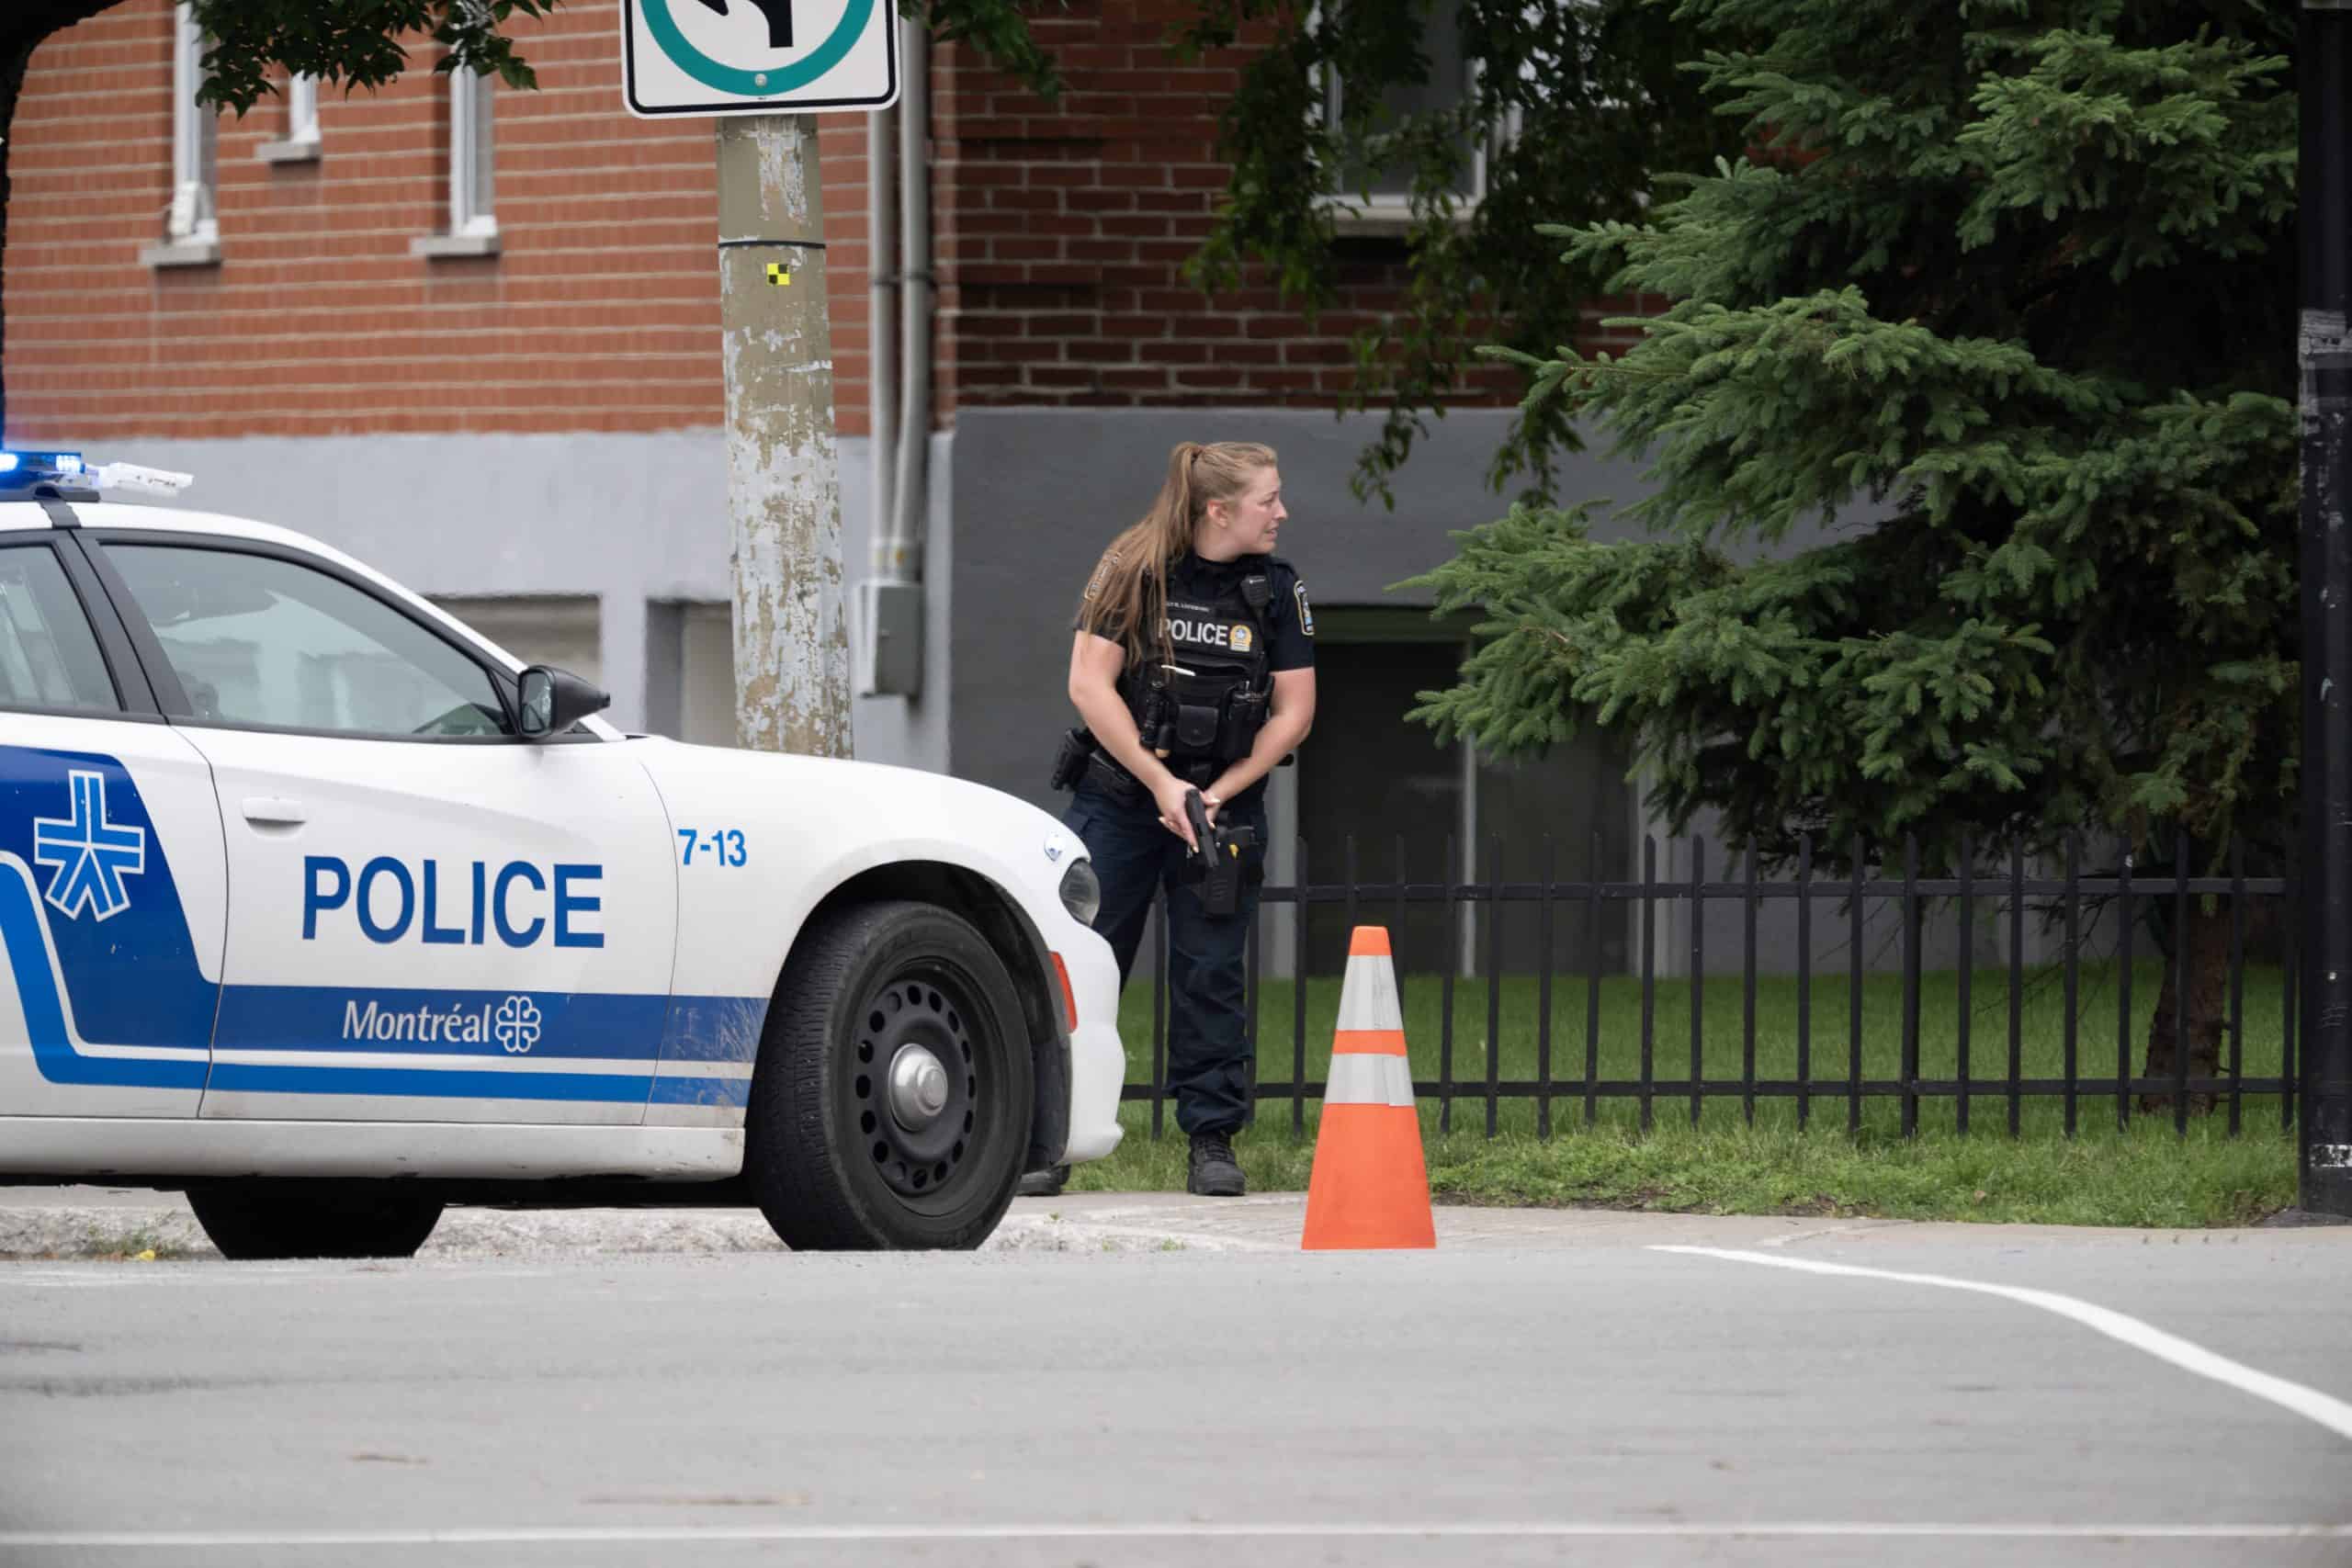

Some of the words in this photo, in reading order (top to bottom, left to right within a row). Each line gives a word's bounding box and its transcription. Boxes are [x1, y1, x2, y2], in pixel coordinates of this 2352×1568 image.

[1158, 617, 1228, 646] POLICE
[678, 829, 747, 867] 7-13
[302, 855, 605, 949] POLICE
[343, 1000, 491, 1043] Montréal
